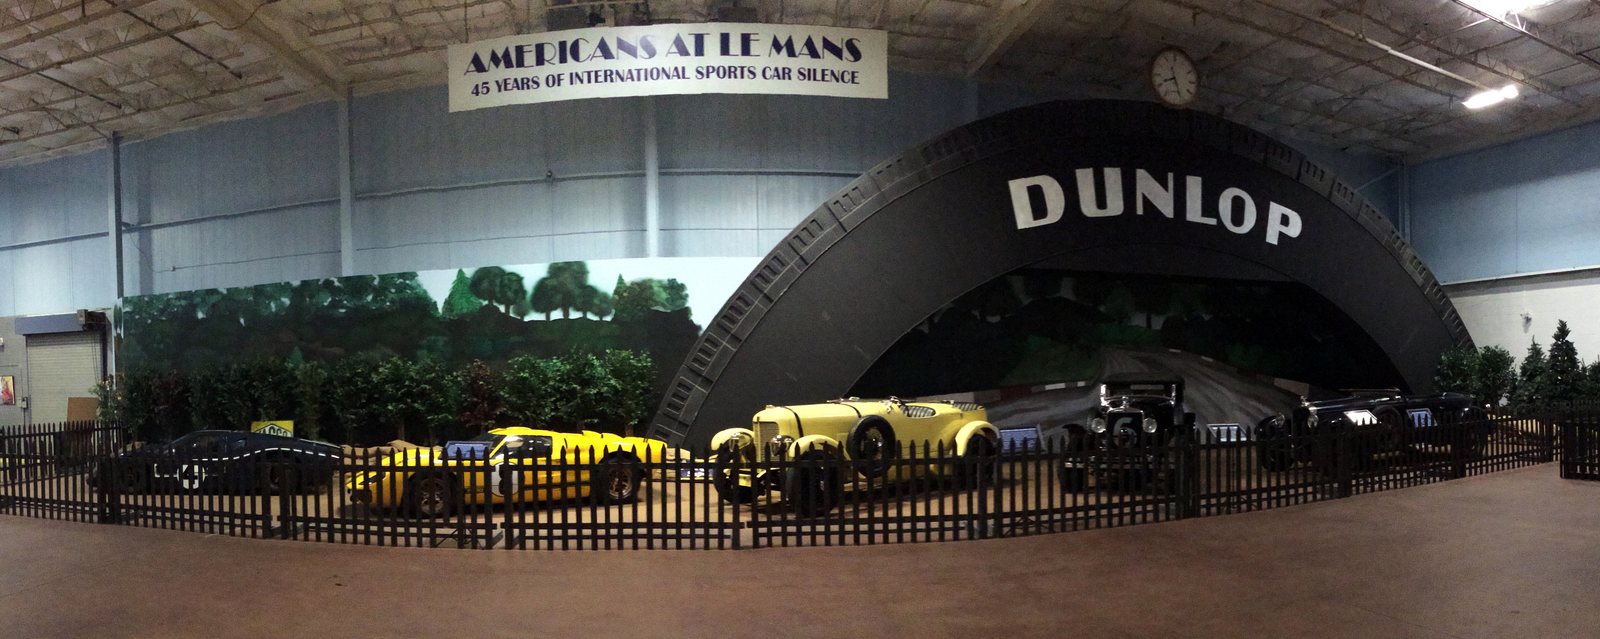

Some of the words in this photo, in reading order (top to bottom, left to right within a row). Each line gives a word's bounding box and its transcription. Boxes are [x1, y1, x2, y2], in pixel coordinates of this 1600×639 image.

[464, 34, 657, 75] AMERICANS
[665, 33, 710, 57] AT
[720, 33, 760, 57] LE
[768, 34, 863, 63] MANS
[471, 81, 490, 97] 45
[495, 76, 540, 93] YEARS
[545, 73, 565, 88] OF
[569, 66, 691, 86] INTERNATIONAL
[695, 66, 757, 80] SPORTS
[761, 66, 792, 81] CAR
[797, 67, 861, 85] SILENCE
[1008, 167, 1302, 246] DUNLOP
